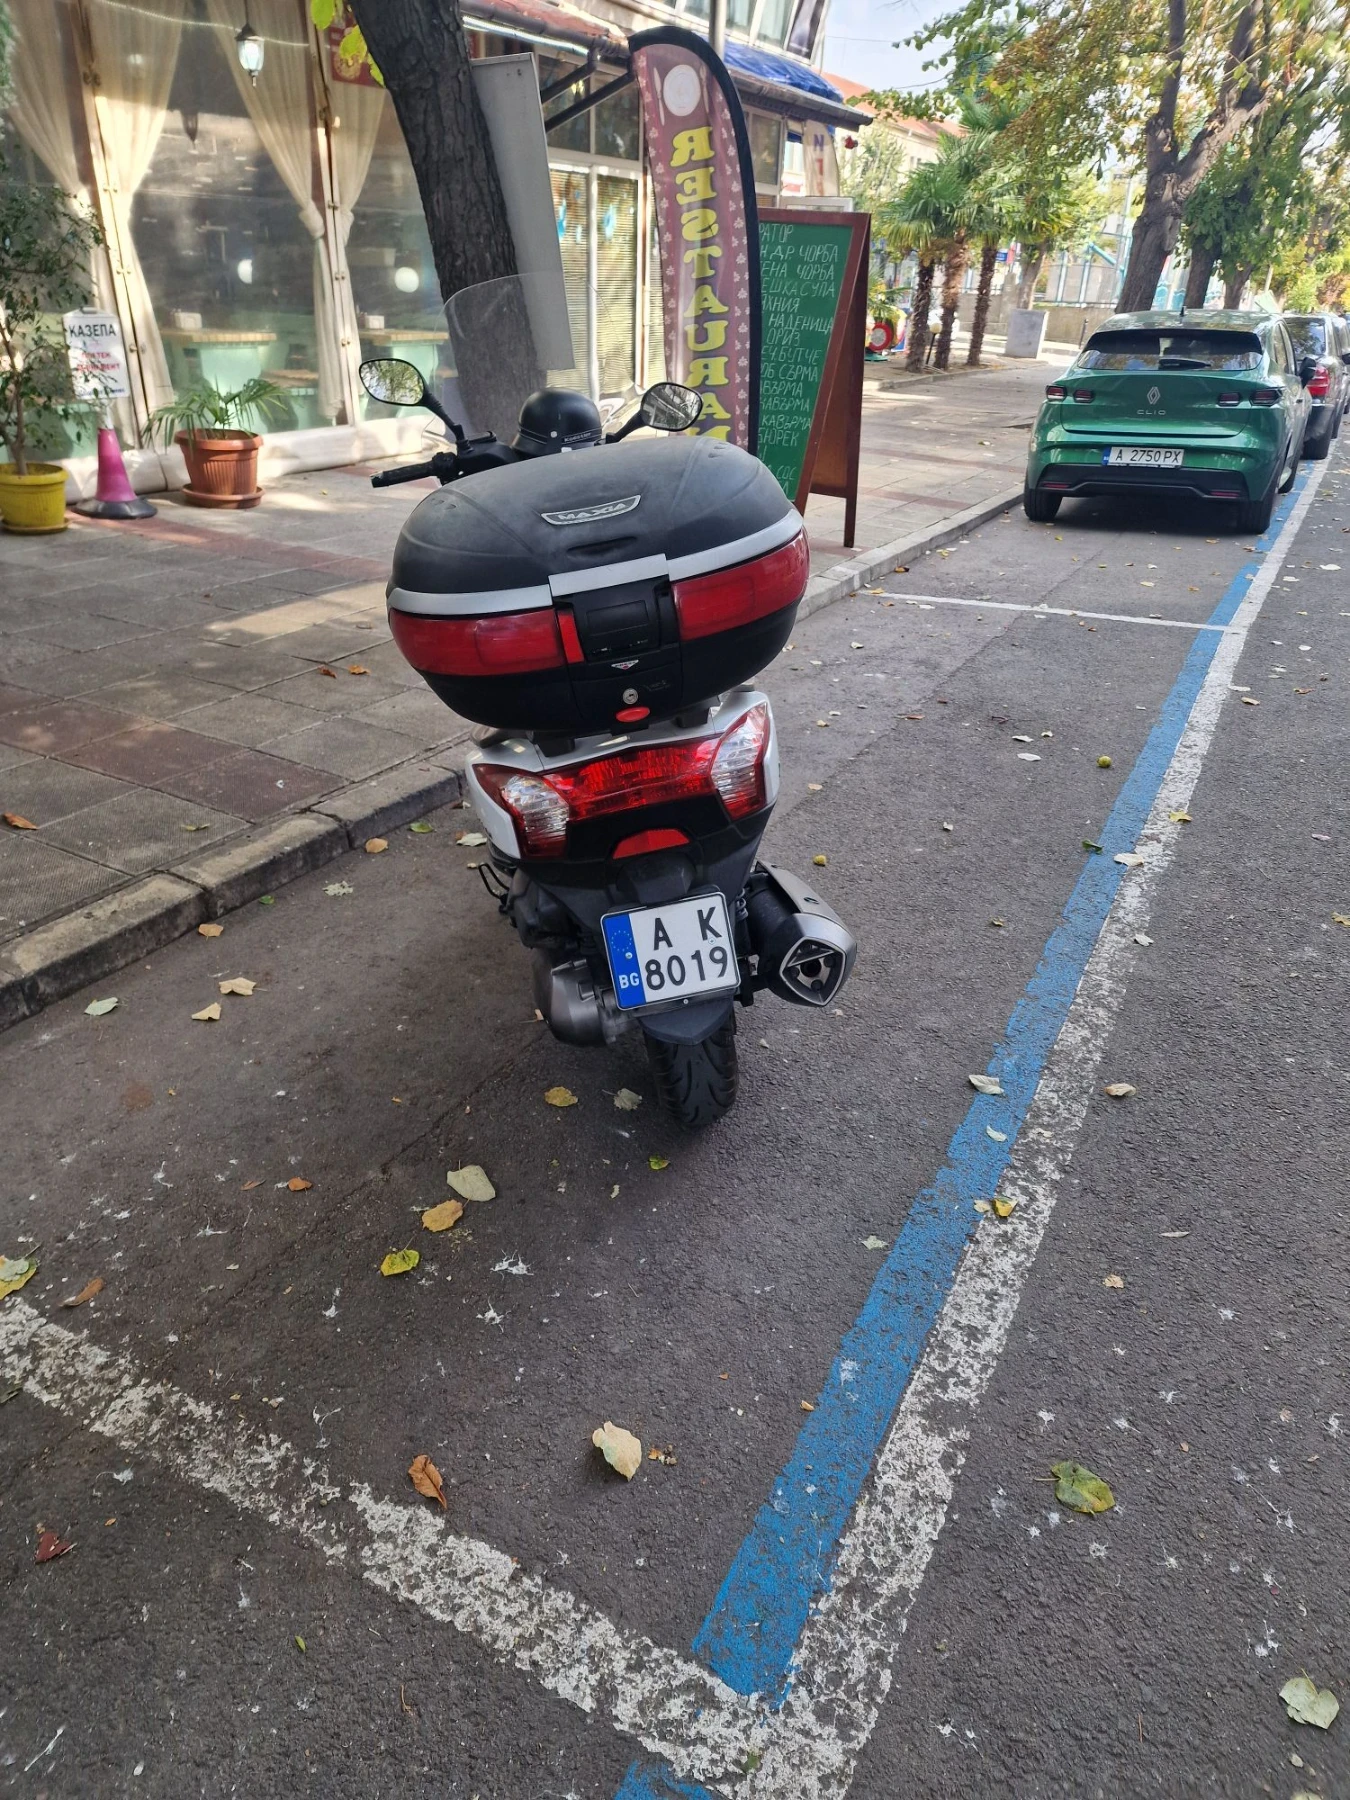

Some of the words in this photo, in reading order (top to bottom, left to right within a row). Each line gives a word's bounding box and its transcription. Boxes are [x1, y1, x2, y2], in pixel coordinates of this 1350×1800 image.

[799, 244, 839, 263] ЧОРБА
[760, 261, 788, 278] ЕНА
[797, 264, 835, 281] ЧОРБА
[69, 324, 117, 337] КАЗЕПА
[767, 328, 800, 347] ОРИЗ
[779, 364, 818, 382] СЪРМА
[760, 380, 803, 398] ВЪРМА
[762, 414, 812, 431] КАВЪРМА
[1115, 449, 1123, 462] A
[1130, 449, 1162, 463] 2750
[1163, 451, 1182, 464] PX
[775, 465, 798, 480] СОС
[653, 917, 673, 951] A
[697, 906, 723, 942] K
[644, 946, 729, 991] 8019
[618, 972, 640, 989] BG
